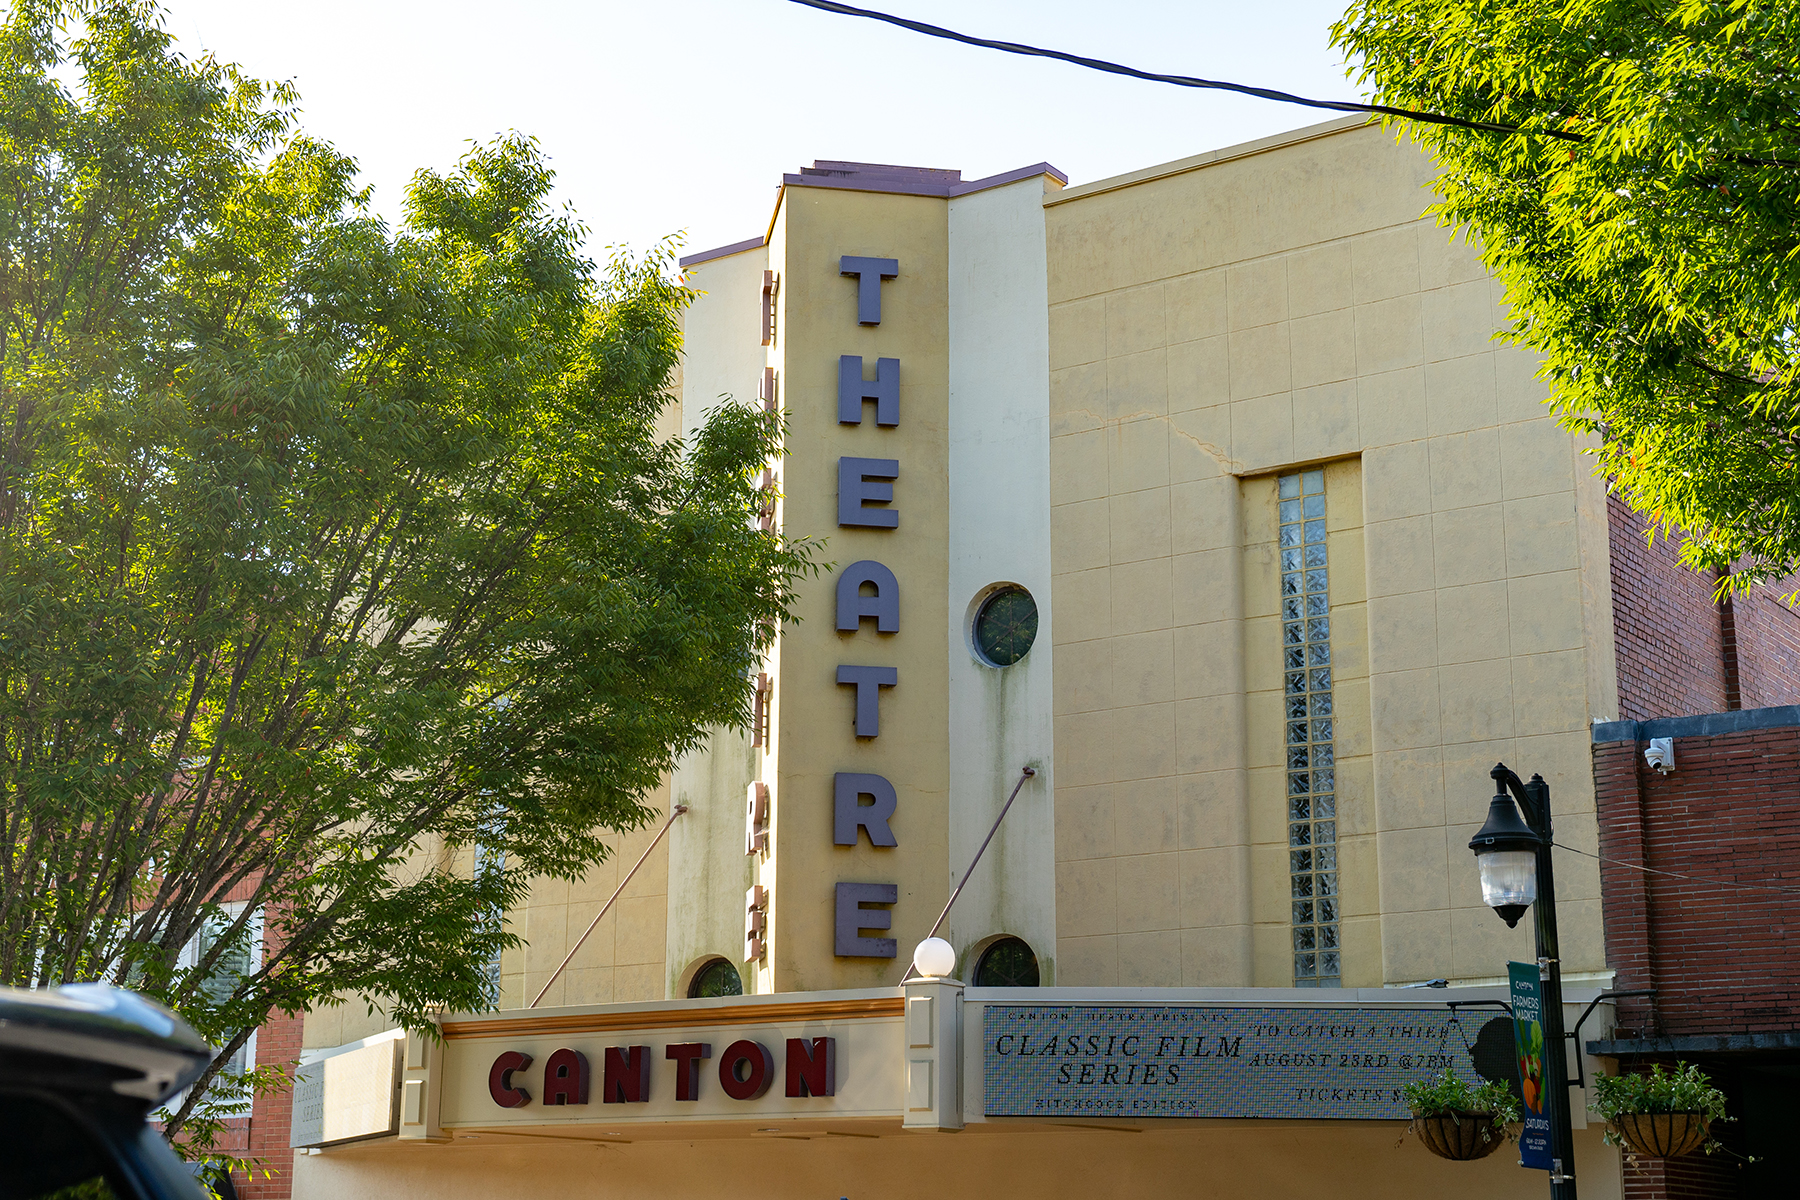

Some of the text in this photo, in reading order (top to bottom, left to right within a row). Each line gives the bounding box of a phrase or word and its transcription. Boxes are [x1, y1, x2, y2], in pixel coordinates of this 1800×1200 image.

[835, 255, 900, 959] THEATRE
[1512, 994, 1540, 1010] FARMERS
[1077, 1013, 1147, 1022] HEATRE
[1515, 1008, 1539, 1021] MARKET
[1289, 1024, 1357, 1038] CATCH
[1365, 1025, 1376, 1038] A
[995, 1034, 1243, 1058] CLASSIC FILM
[1248, 1053, 1332, 1067] AUGUST
[1339, 1053, 1390, 1068] 23RD
[488, 1036, 836, 1109] CANTON
[1056, 1063, 1181, 1086] SERIES
[1295, 1088, 1384, 1101] TICKETS
[1035, 1099, 1198, 1111] HITCHCOCK EDITION
